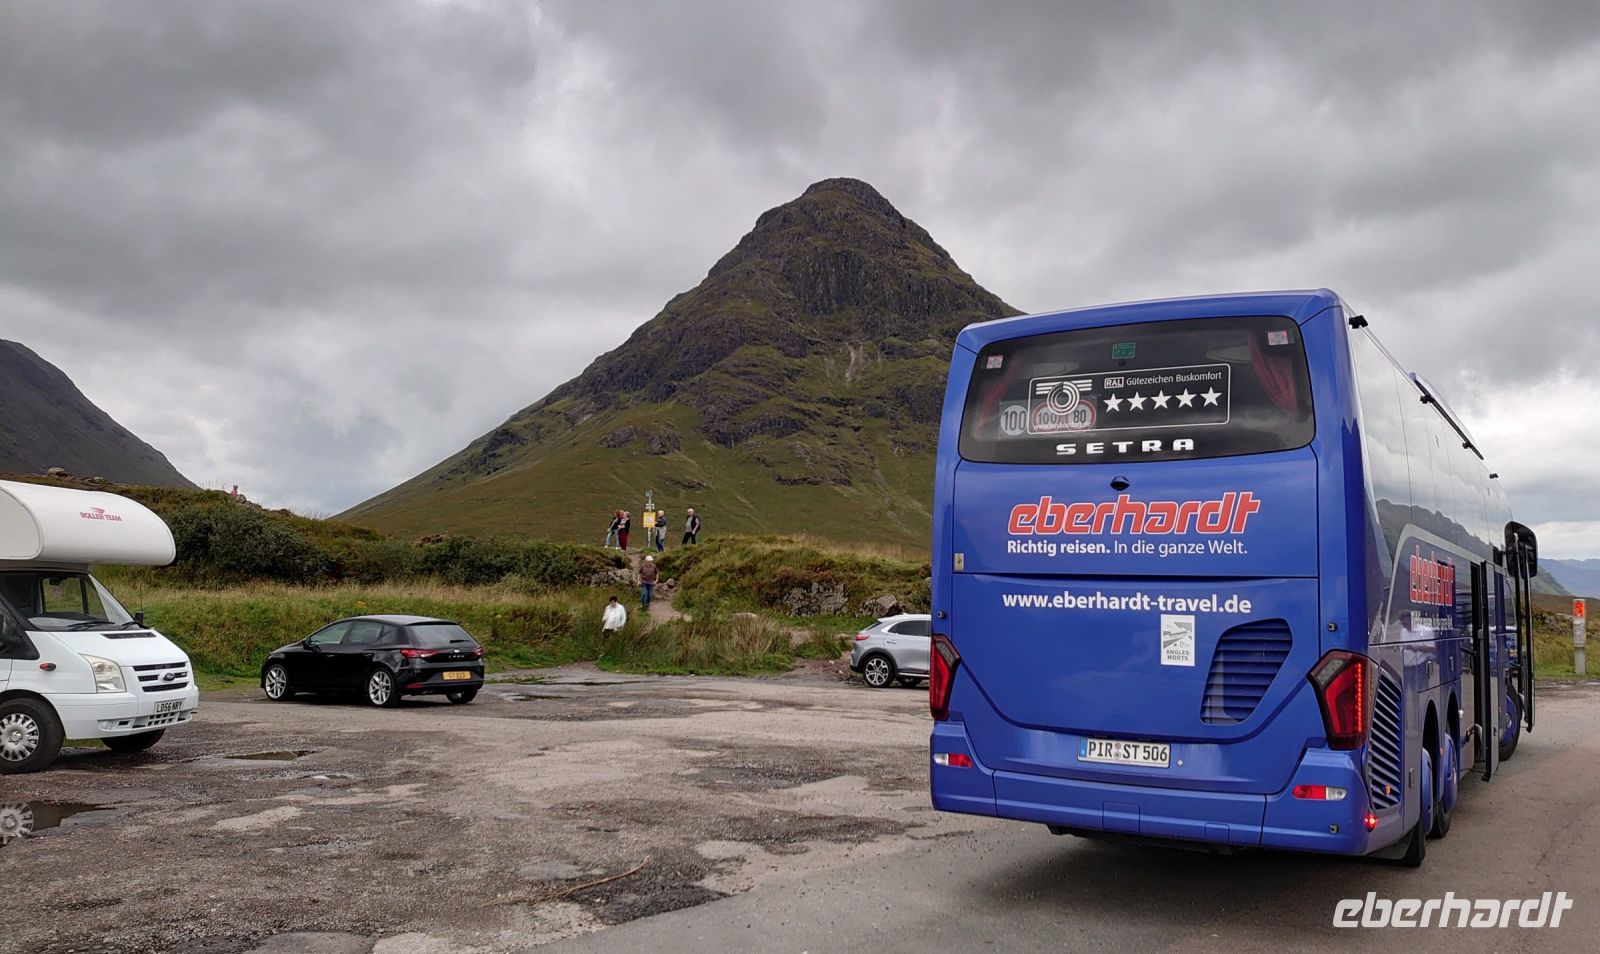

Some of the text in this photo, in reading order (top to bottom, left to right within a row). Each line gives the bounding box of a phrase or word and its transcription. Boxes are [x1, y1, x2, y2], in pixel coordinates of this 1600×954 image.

[1106, 371, 1222, 387] RAL Gütezeichen Buskomfort
[1003, 410, 1027, 431] 100
[1073, 409, 1087, 424] 80
[1056, 438, 1194, 455] SETRA
[80, 512, 104, 520] ROLLER
[1008, 492, 1260, 534] eberhardt
[1007, 540, 1248, 557] Richtig reisen. In die ganze Welt.
[1002, 591, 1252, 613] www.eberhardt-travel.de
[1088, 741, 1168, 762] PIR ST 506
